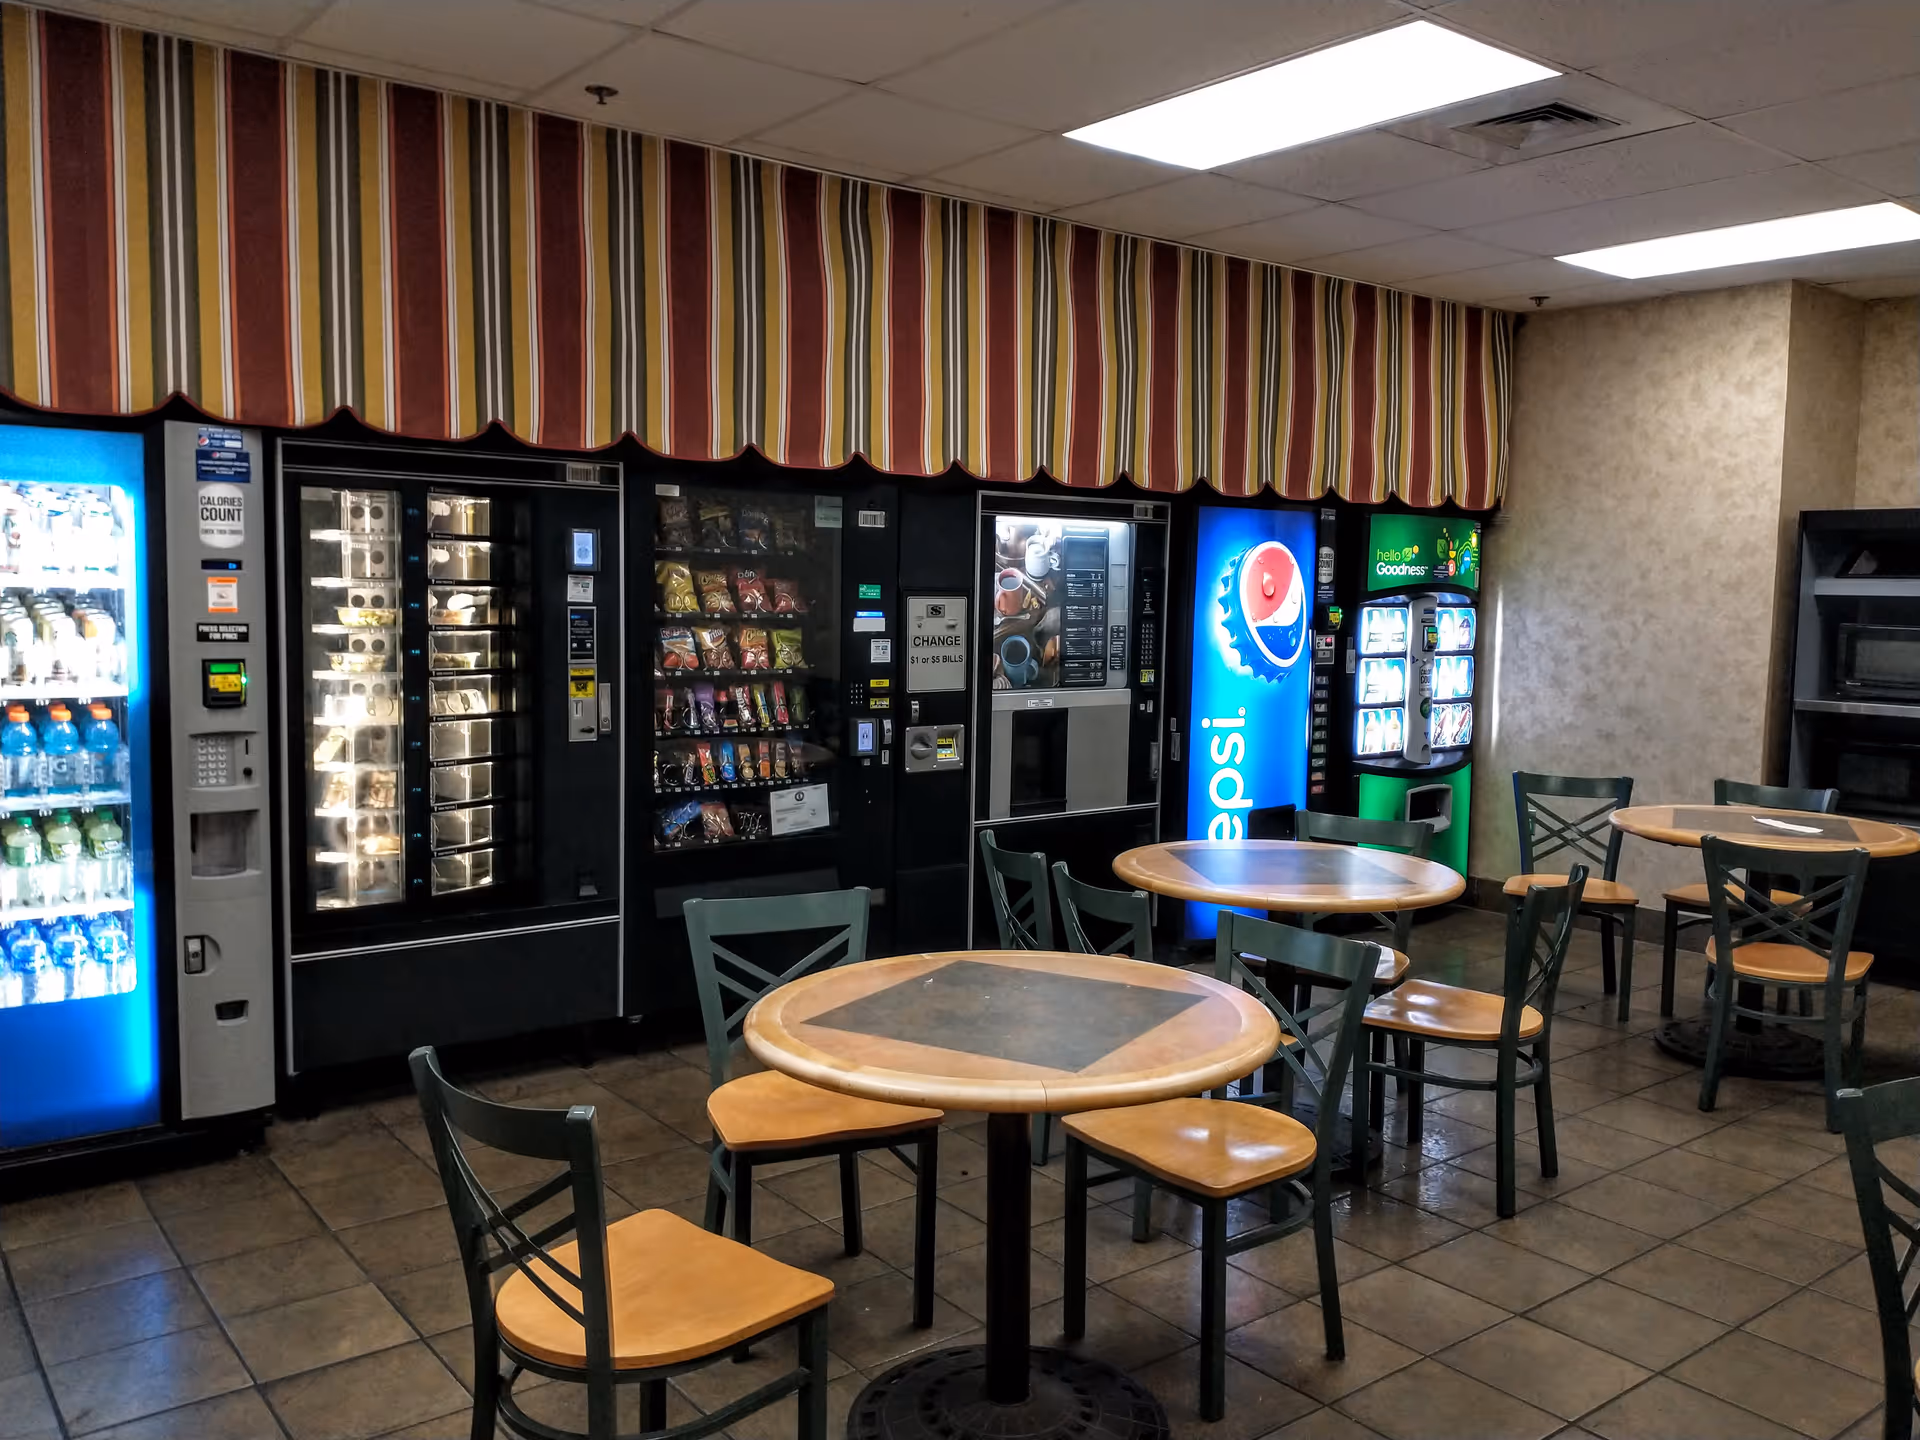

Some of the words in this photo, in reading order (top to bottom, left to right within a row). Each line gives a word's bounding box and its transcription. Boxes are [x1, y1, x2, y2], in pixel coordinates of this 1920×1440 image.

[200, 495, 243, 507] CALORIES
[200, 507, 243, 522] COUNT
[1376, 548, 1401, 561] hello
[1376, 562, 1426, 576] Goodness
[913, 635, 961, 647] CHANGE
[910, 655, 919, 664] $1
[931, 655, 941, 664] $5
[942, 654, 964, 663] BILLS
[1201, 717, 1253, 840] epsi
